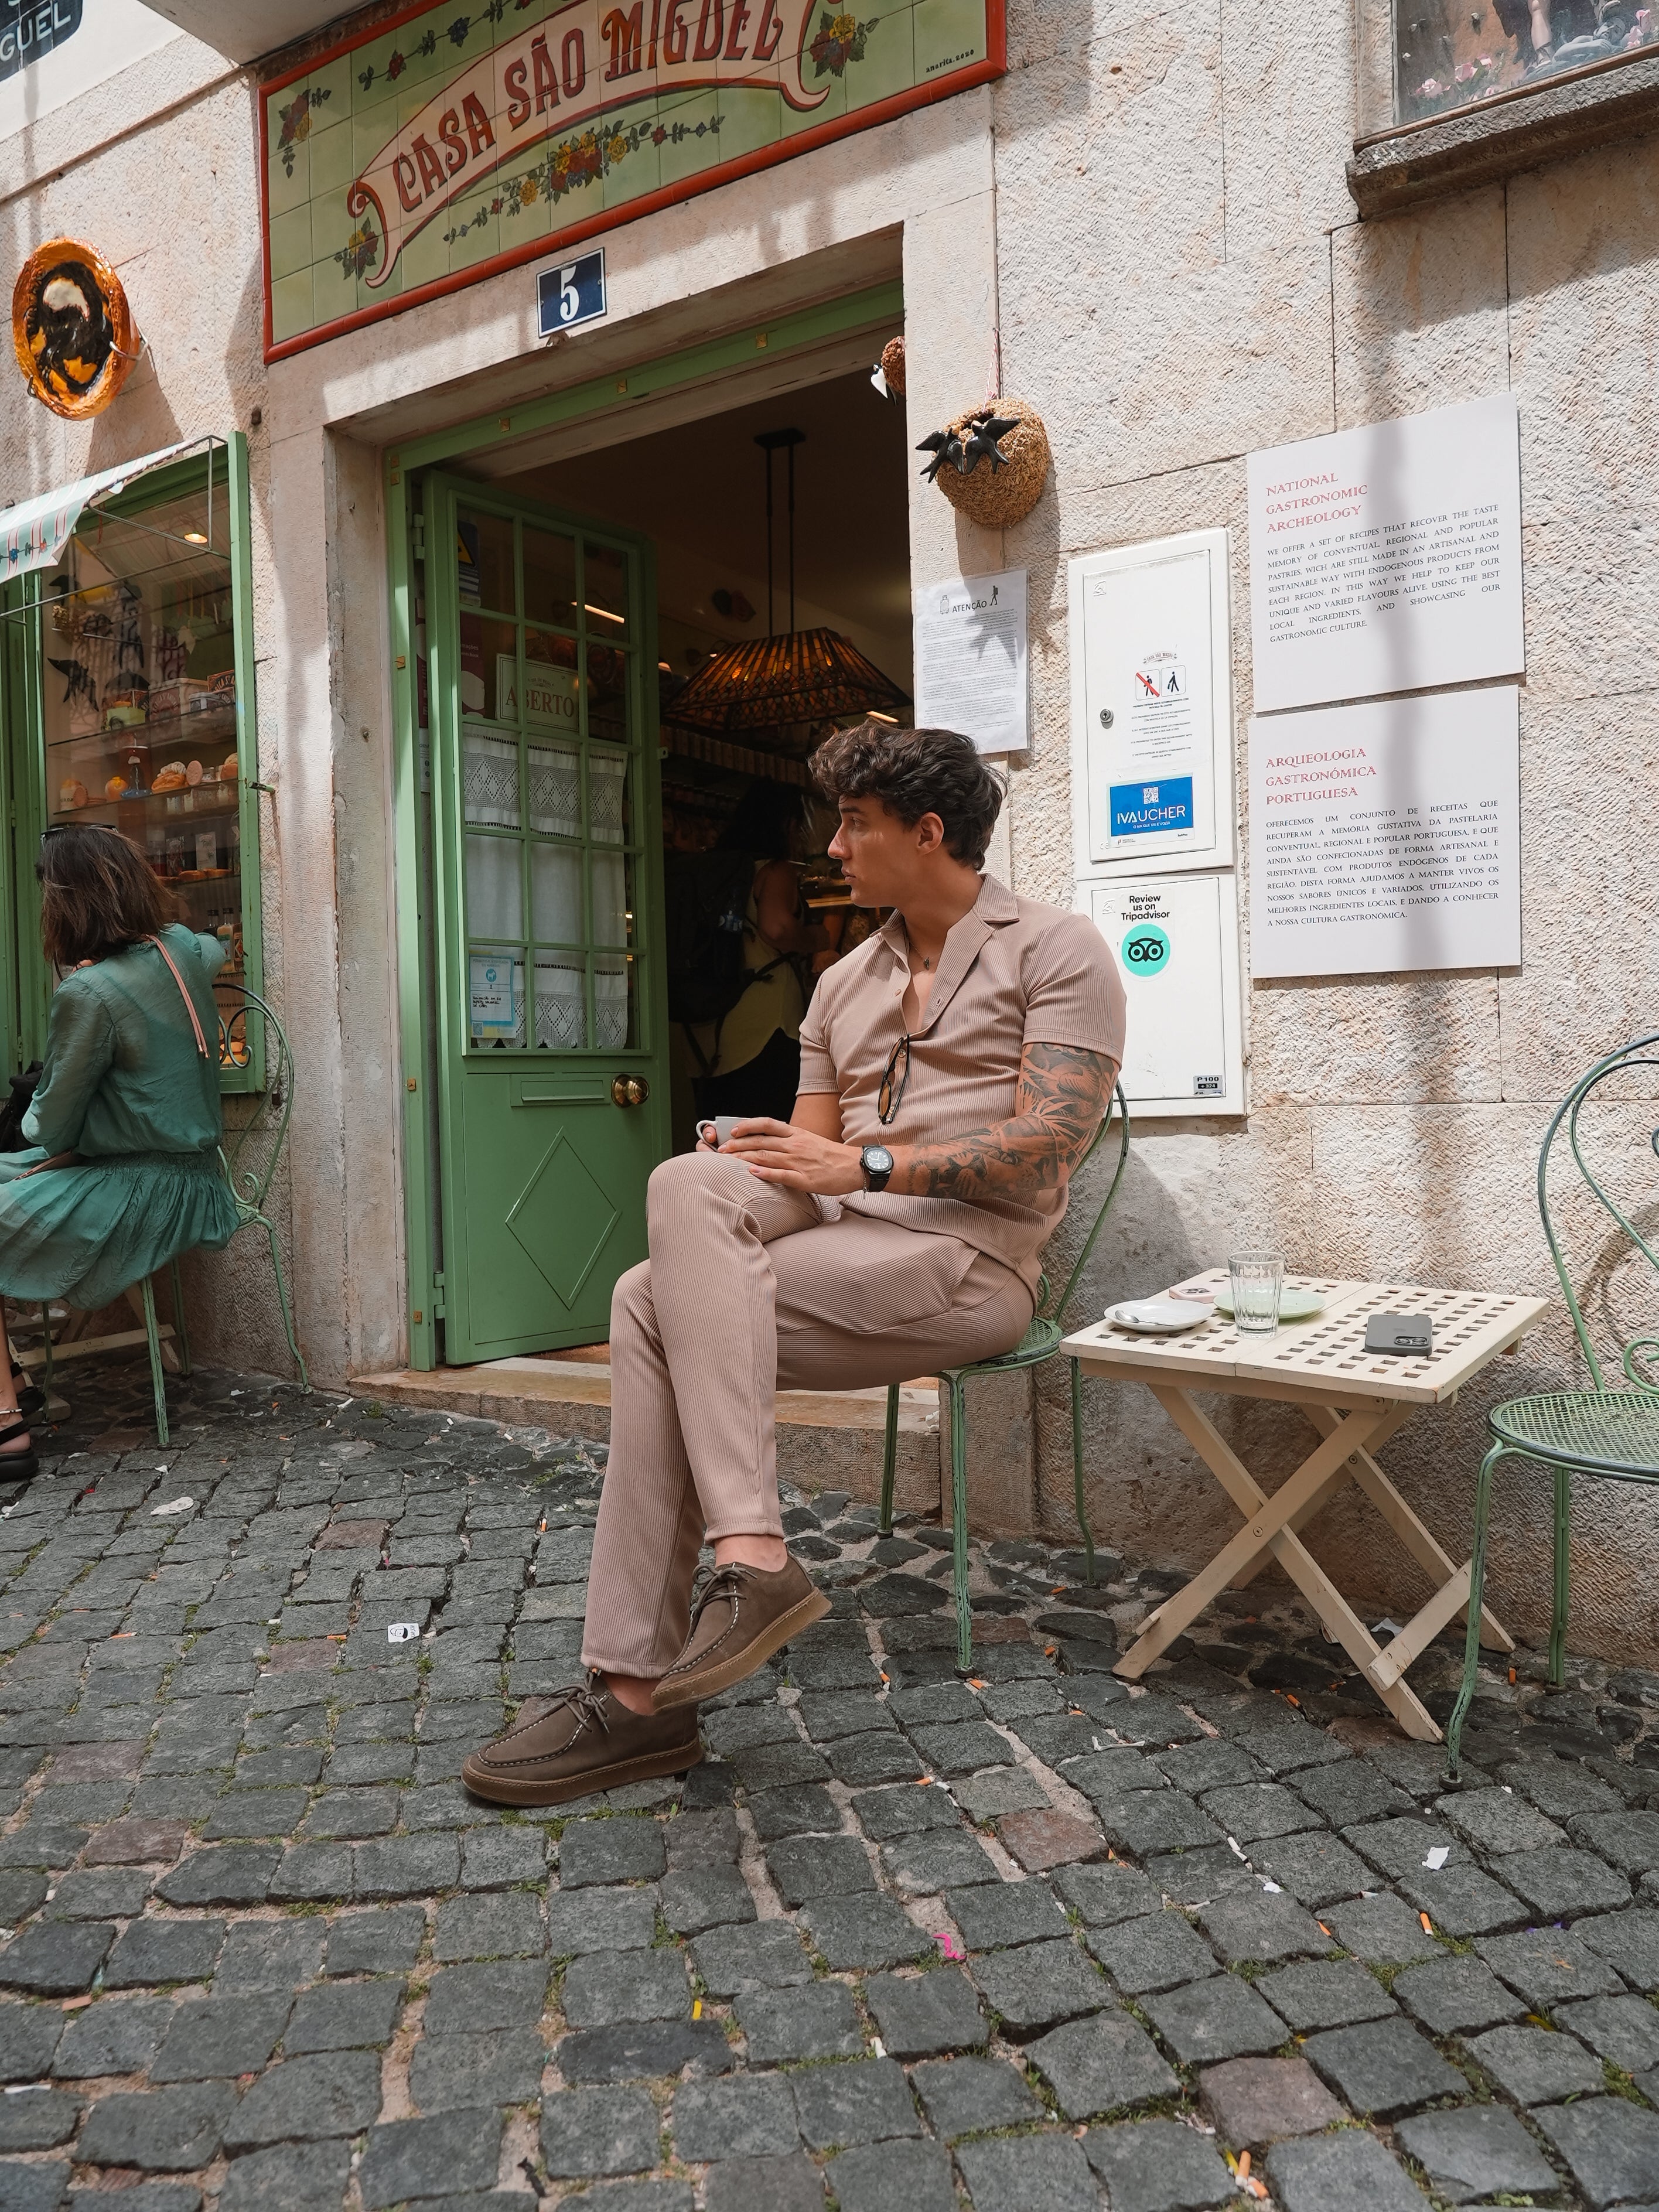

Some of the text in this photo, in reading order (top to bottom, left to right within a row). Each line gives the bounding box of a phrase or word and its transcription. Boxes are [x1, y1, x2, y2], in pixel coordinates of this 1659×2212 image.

[393, 0, 783, 213] CASA SÃO MIGUEL
[560, 265, 579, 321] 5
[1266, 473, 1339, 496] NATIONAL
[1266, 484, 1367, 515] GASTRONOMIC
[1267, 504, 1361, 534] ARCHEOLOGY
[1282, 543, 1305, 553] OFFER
[1319, 538, 1332, 547] SET
[1335, 535, 1346, 543] OF
[1349, 528, 1380, 540] RECIPES
[1382, 523, 1407, 534] THAT
[1410, 514, 1448, 528] RECOVER
[1452, 510, 1469, 520] THE
[1472, 504, 1498, 515] TASTE
[1267, 556, 1302, 569] MEMORY
[1308, 552, 1318, 561] OF
[1386, 531, 1428, 546] REGIONAL
[1433, 527, 1453, 537] AND
[1459, 517, 1498, 531] POPULAR
[1305, 564, 1327, 574] WICH
[1330, 560, 1346, 569] ARE
[1349, 556, 1370, 566] STILL
[1372, 550, 1397, 562] MADE
[1399, 548, 1409, 556] IN
[1412, 545, 1425, 554] AN
[1429, 535, 1476, 551] ARTISANAL
[1479, 531, 1499, 541] AND
[1268, 543, 1500, 593] SUSTAINABLE WAY WITH ENDOGENOUS PRODUCTS FROM
[1269, 596, 1289, 606] EACH
[1331, 586, 1340, 595] IN
[1345, 582, 1364, 592] THIS
[1368, 577, 1388, 587] WAY
[1394, 574, 1407, 583] WE
[1411, 569, 1432, 579] HELP
[1437, 566, 1450, 575] TO
[1455, 562, 1475, 572] KEEP
[1480, 557, 1500, 566] OUR
[1269, 606, 1300, 618] UNIQUE
[1303, 603, 1321, 612] AND
[1324, 597, 1354, 608] VARIED
[1357, 588, 1399, 602] FLAVOURS
[1432, 578, 1457, 589] USING
[1460, 574, 1478, 583] THE
[1481, 569, 1501, 580] BEST
[952, 600, 987, 613] ATENÇÃO
[1269, 620, 1295, 630] LOCAL
[1376, 602, 1395, 612] AND
[1409, 589, 1466, 606] SHOWCASING
[1481, 583, 1501, 593] OUR
[1269, 627, 1327, 643] GASTRONOMIC
[1265, 747, 1367, 769] ARQUEOLOGIA
[1265, 766, 1377, 787] GASTRONÓMICA
[1267, 787, 1358, 805] PORTUGUESA
[1117, 805, 1186, 825] IVAUCHER
[1266, 817, 1314, 828] OFERECEMOS
[1350, 810, 1396, 820] CONJUNTO
[1430, 803, 1468, 813] RECEITAS
[1480, 800, 1498, 808] QUE
[1266, 830, 1312, 841] RECUPERAM
[1332, 825, 1370, 835] MEMÓRIA
[1377, 820, 1422, 830] GUSTATIVA
[1449, 813, 1498, 824] PASTELARIA
[1323, 838, 1364, 848] REGIONAL
[1374, 834, 1411, 844] POPULAR
[1480, 826, 1499, 834] QUE
[1267, 857, 1292, 865] AINDA
[1296, 855, 1312, 863] SÃO
[1316, 849, 1384, 861] CONFECIONADAS
[1388, 847, 1399, 855] DE
[1404, 845, 1435, 854] FORMA
[1439, 840, 1489, 851] ARTESANAL
[1266, 867, 1318, 878] SUSTENTÁVEL
[1323, 865, 1343, 873] COM
[1349, 861, 1392, 871] PRODUTOS
[1398, 856, 1449, 867] ENDÓGENOS
[1473, 853, 1498, 861] CADA
[1327, 877, 1356, 885] FORMA
[1360, 873, 1405, 883] AJUDAMOS
[1418, 869, 1455, 879] MANTER
[1458, 867, 1485, 875] VIVOS
[1129, 894, 1161, 903] Review
[1267, 893, 1295, 902] NOSSOS
[1299, 891, 1332, 900] SABORES
[1336, 888, 1367, 897] ÚNICOS
[1429, 880, 1483, 890] UTILIZANDO
[1267, 905, 1307, 914] MELHORES
[1309, 901, 1365, 912] INGREDIENTES
[1407, 896, 1440, 905] DANDO
[1452, 892, 1499, 902] CONHECER
[1121, 910, 1170, 922] Tripadvisor
[1300, 916, 1338, 924] CULTURA
